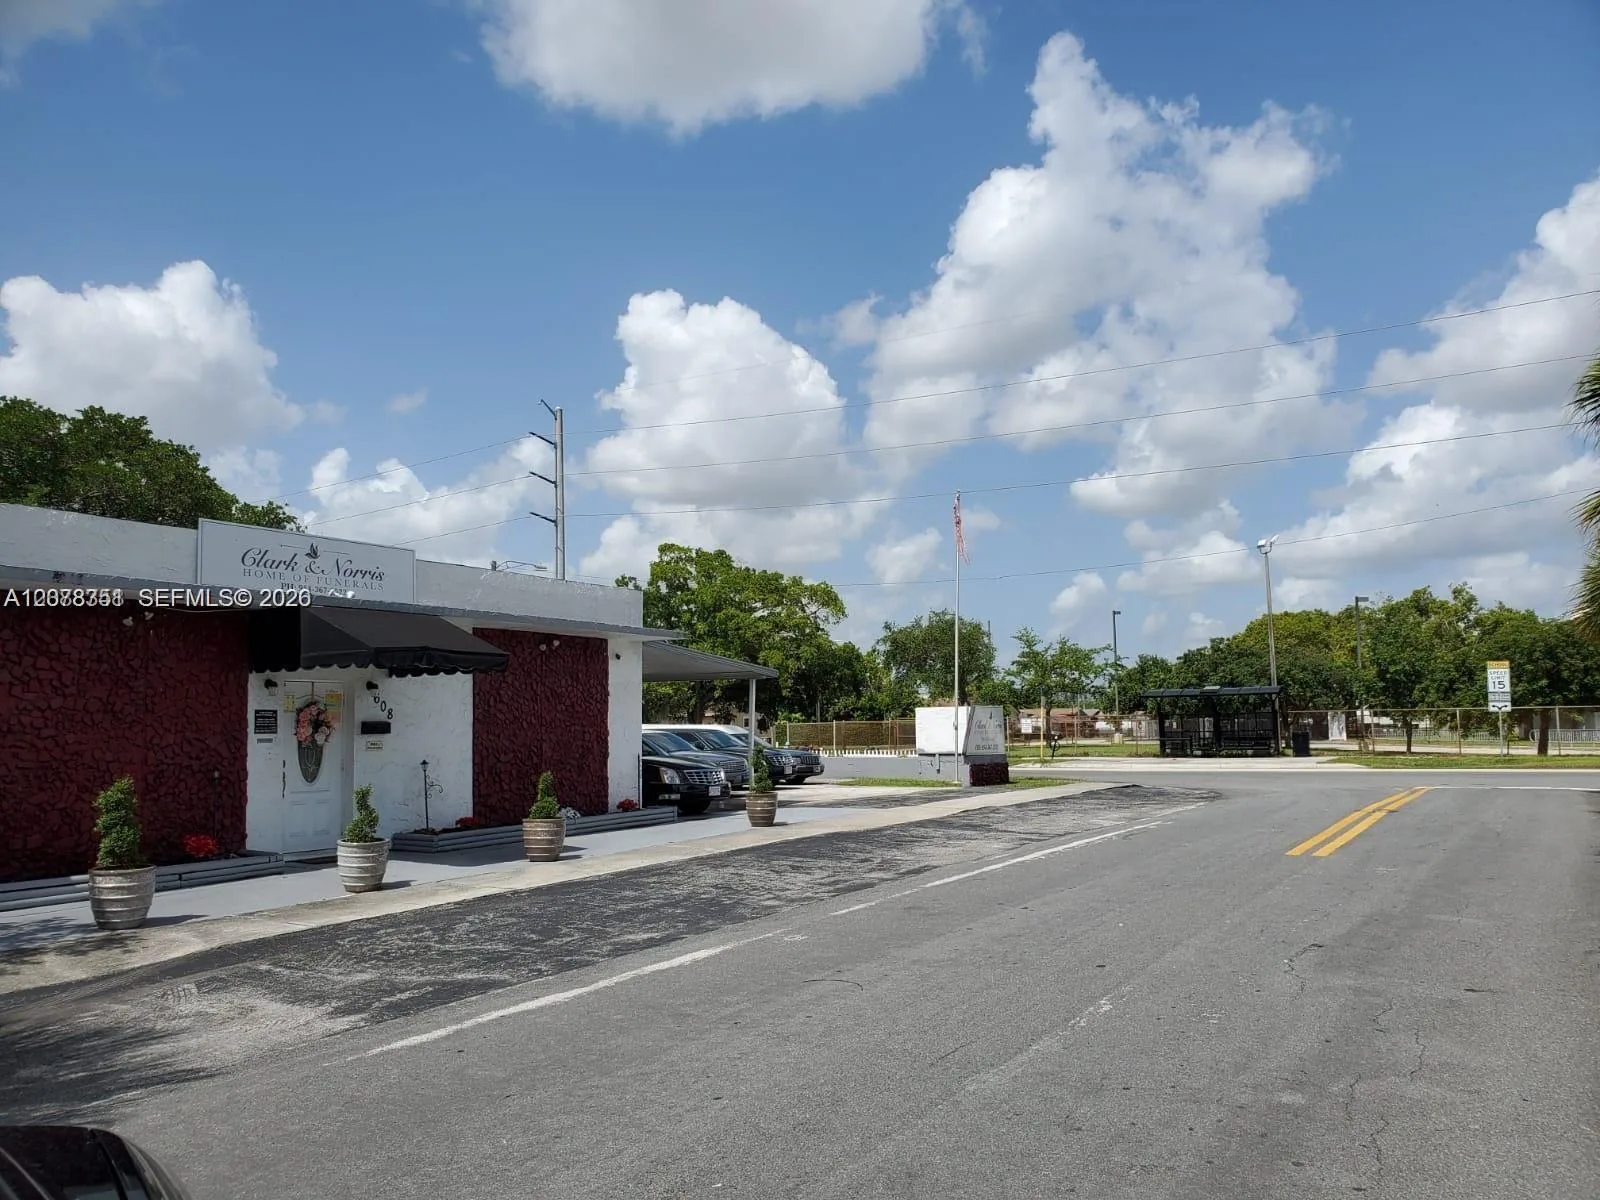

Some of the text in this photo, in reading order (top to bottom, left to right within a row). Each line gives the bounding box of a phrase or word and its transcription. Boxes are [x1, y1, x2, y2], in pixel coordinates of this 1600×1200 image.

[241, 547, 385, 582] Clark & Norris
[243, 568, 384, 591] HOME OF FUNERALS
[1492, 681, 1506, 689] 15
